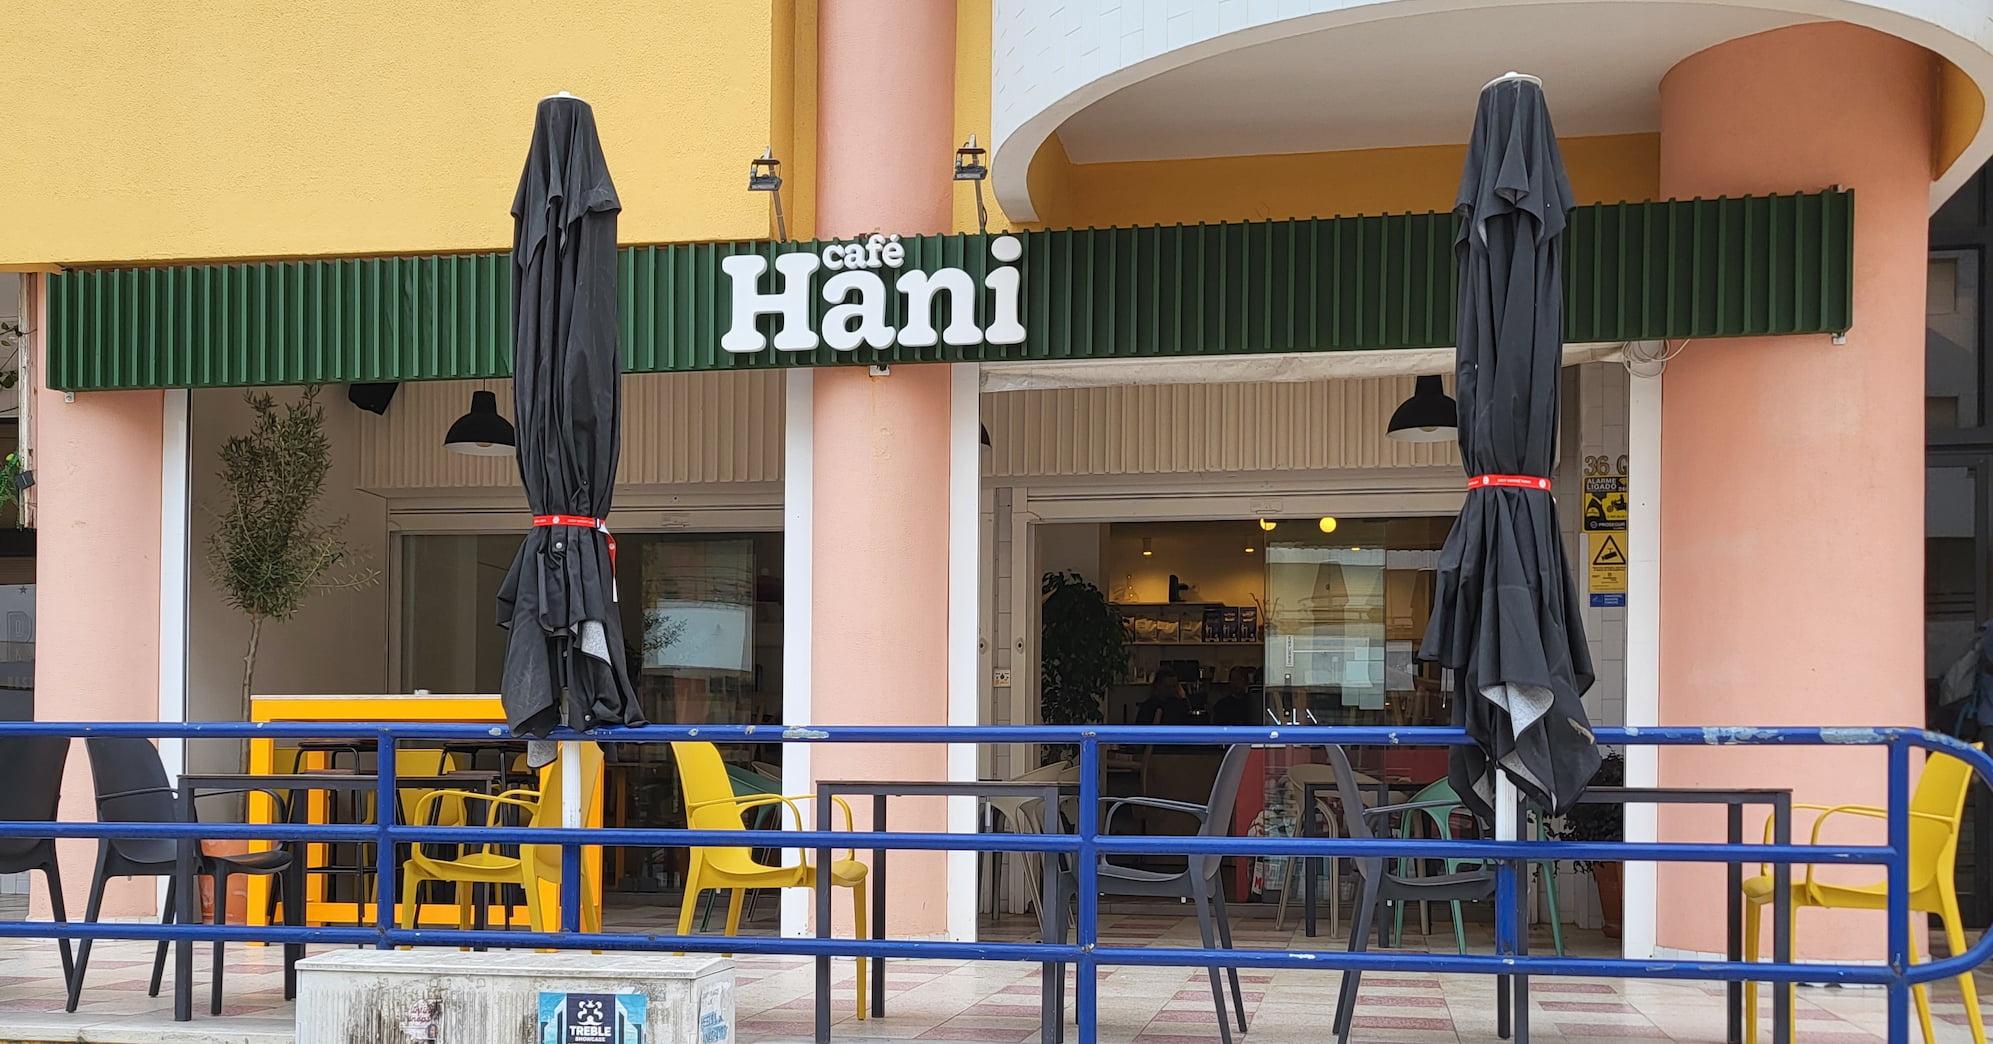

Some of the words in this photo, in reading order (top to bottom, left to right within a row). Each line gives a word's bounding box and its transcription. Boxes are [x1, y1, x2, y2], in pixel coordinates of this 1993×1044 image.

[822, 233, 905, 270] café
[721, 235, 1027, 353] Hani
[1584, 455, 1610, 476] 36
[569, 1025, 612, 1037] TREBLE
